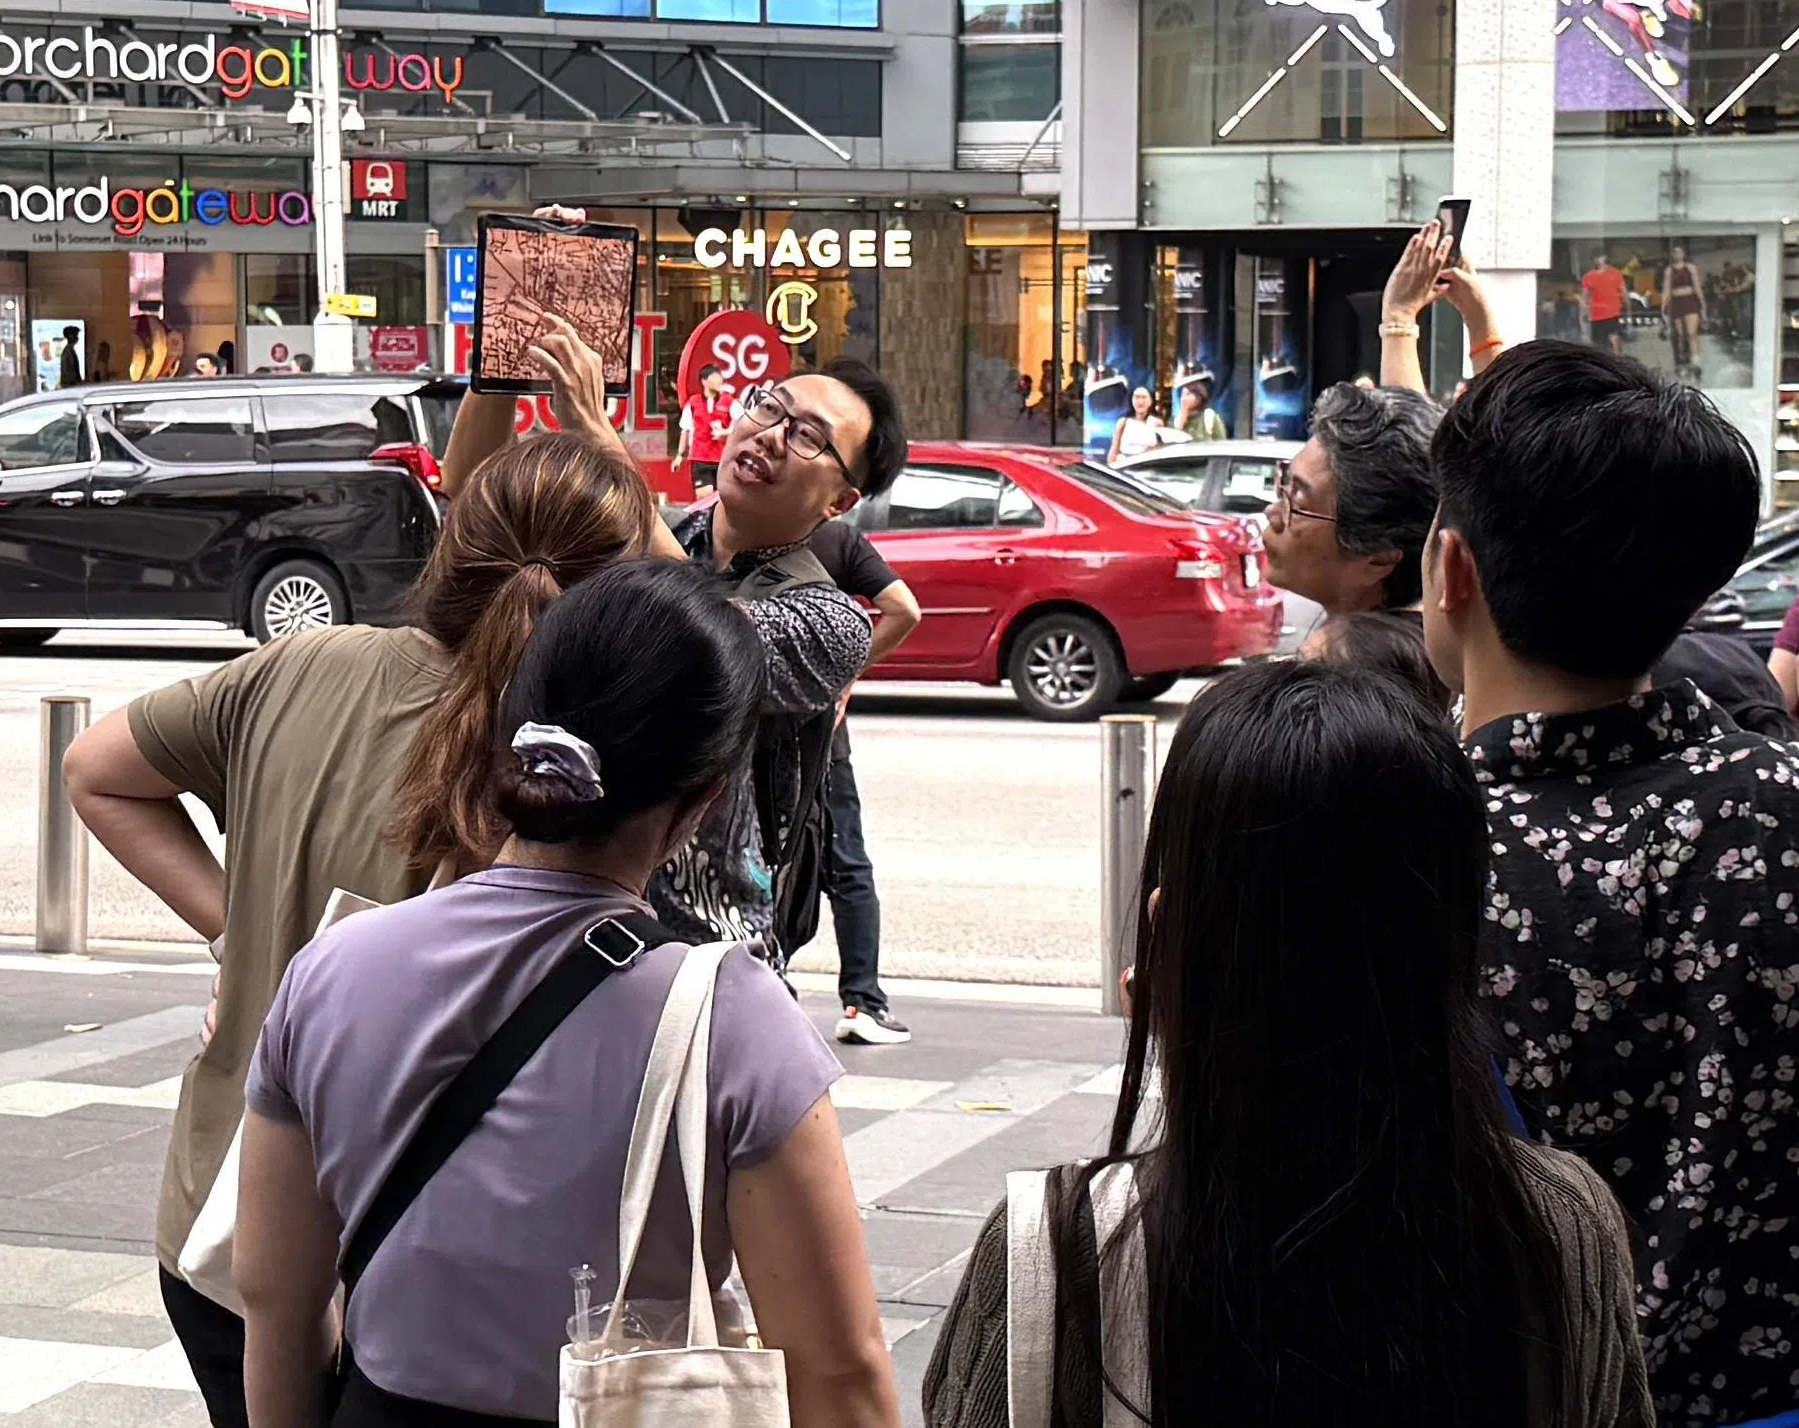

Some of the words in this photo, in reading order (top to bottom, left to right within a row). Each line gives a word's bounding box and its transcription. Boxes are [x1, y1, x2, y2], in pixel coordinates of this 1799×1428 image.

[362, 200, 399, 217] MRT
[694, 228, 913, 268] CHAGEE
[712, 333, 769, 379] SG
